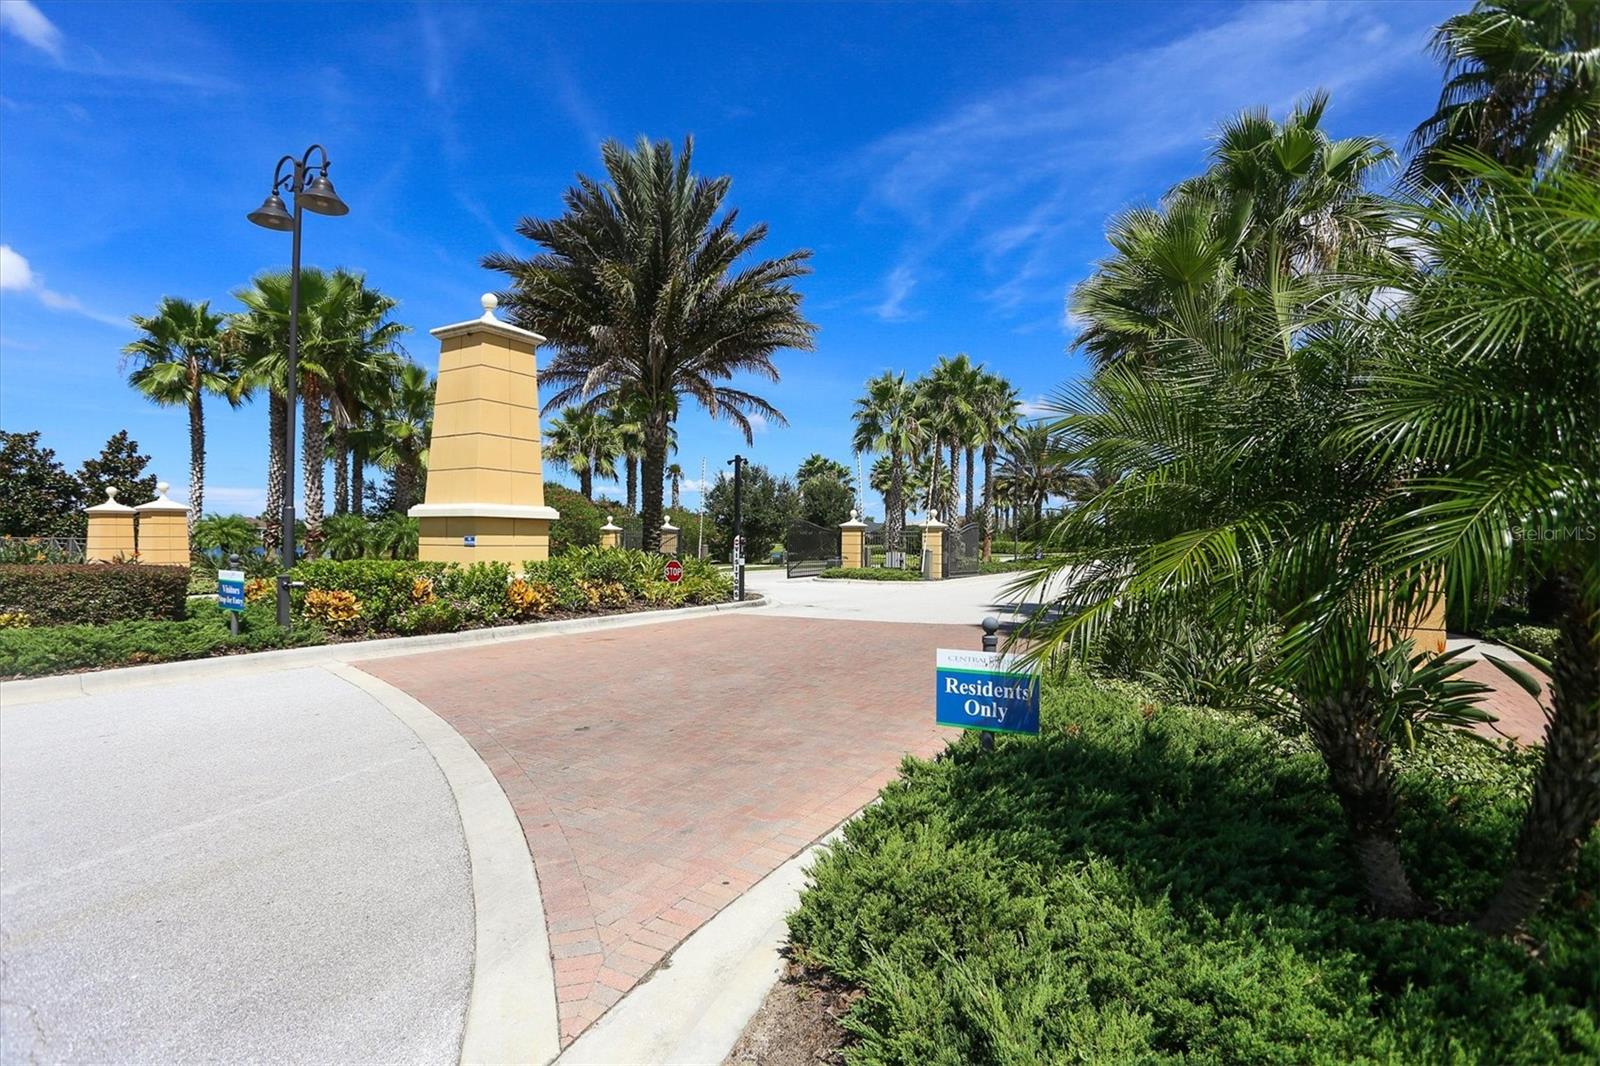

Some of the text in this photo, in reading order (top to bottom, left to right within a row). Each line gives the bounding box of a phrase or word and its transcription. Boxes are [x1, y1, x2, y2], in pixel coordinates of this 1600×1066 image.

[666, 567, 682, 576] STOP
[222, 585, 240, 595] Visitors
[945, 677, 1030, 701] Residents
[964, 699, 1008, 723] Only
